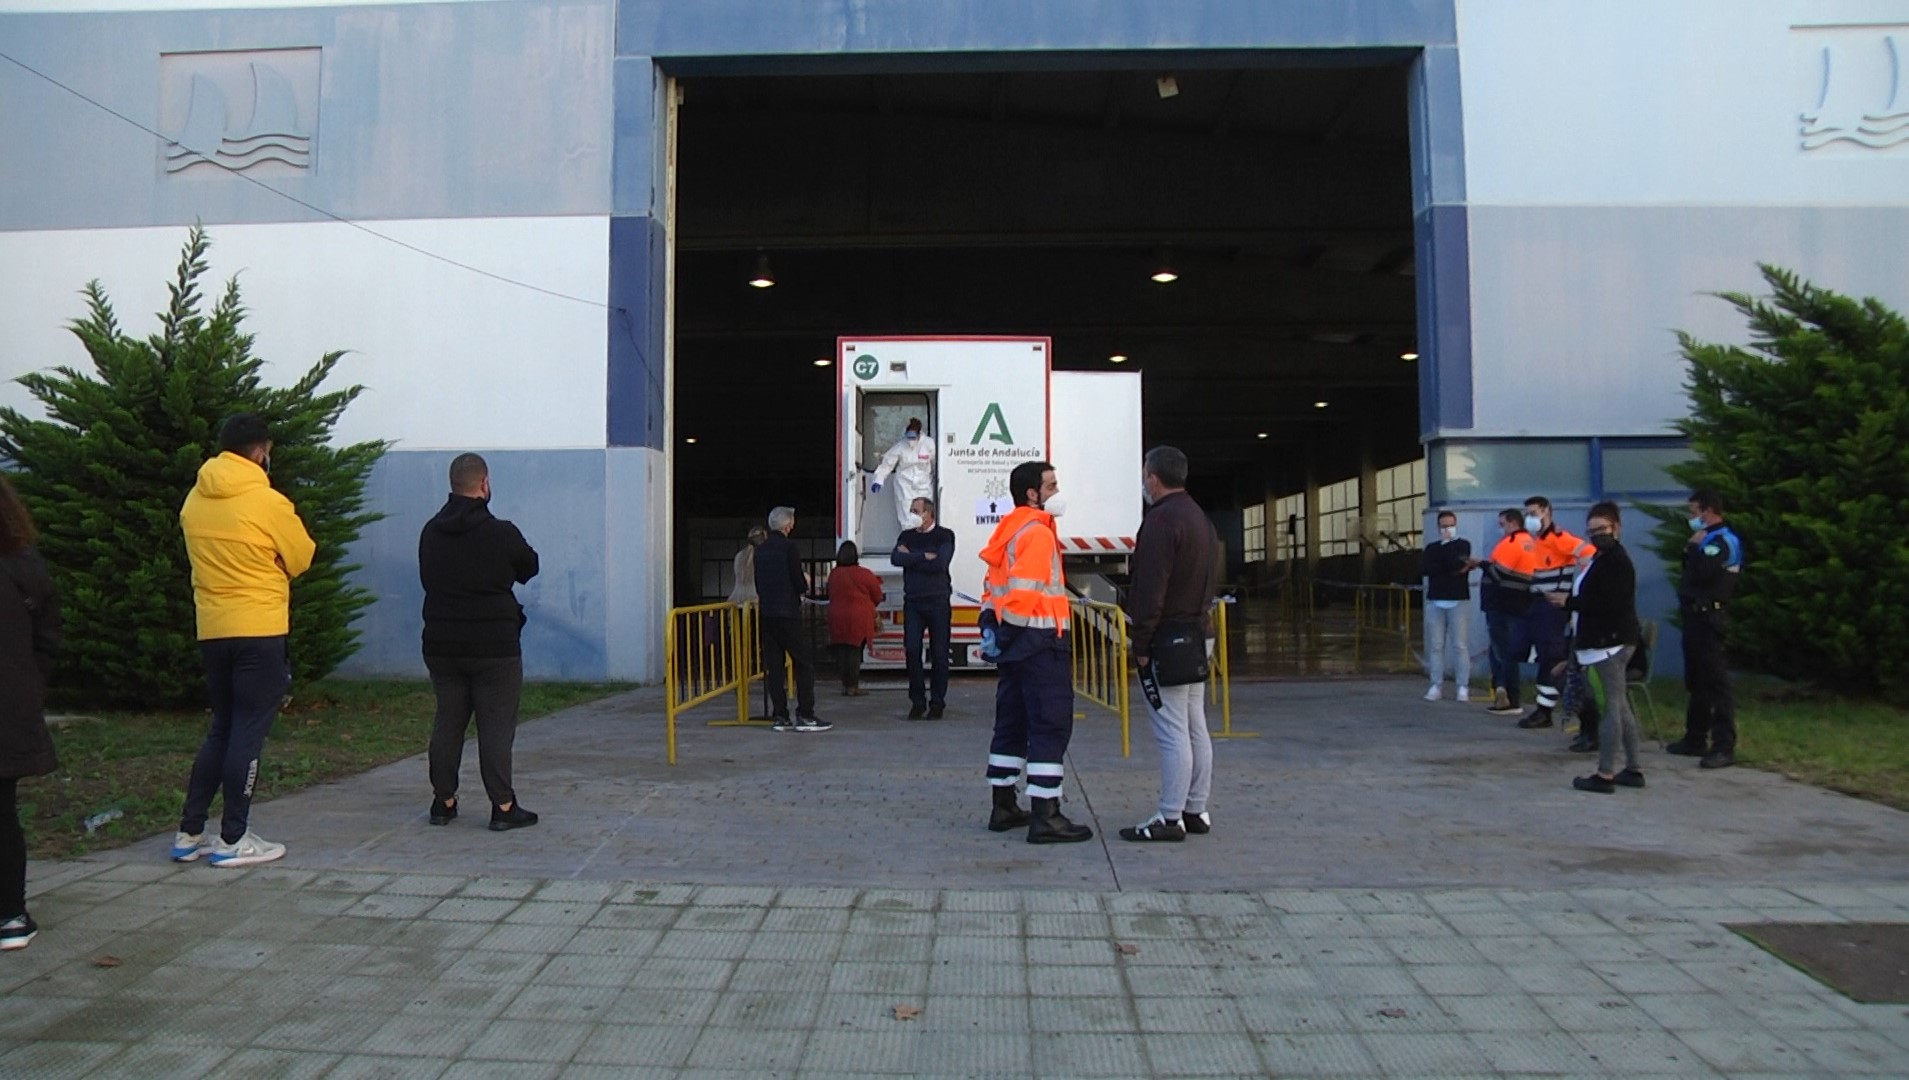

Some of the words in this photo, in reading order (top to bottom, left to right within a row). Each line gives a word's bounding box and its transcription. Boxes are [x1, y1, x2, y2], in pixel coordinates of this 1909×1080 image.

[855, 361, 877, 374] C7
[948, 447, 976, 457] Junta
[978, 447, 990, 457] de
[992, 446, 1040, 457] Andalucía
